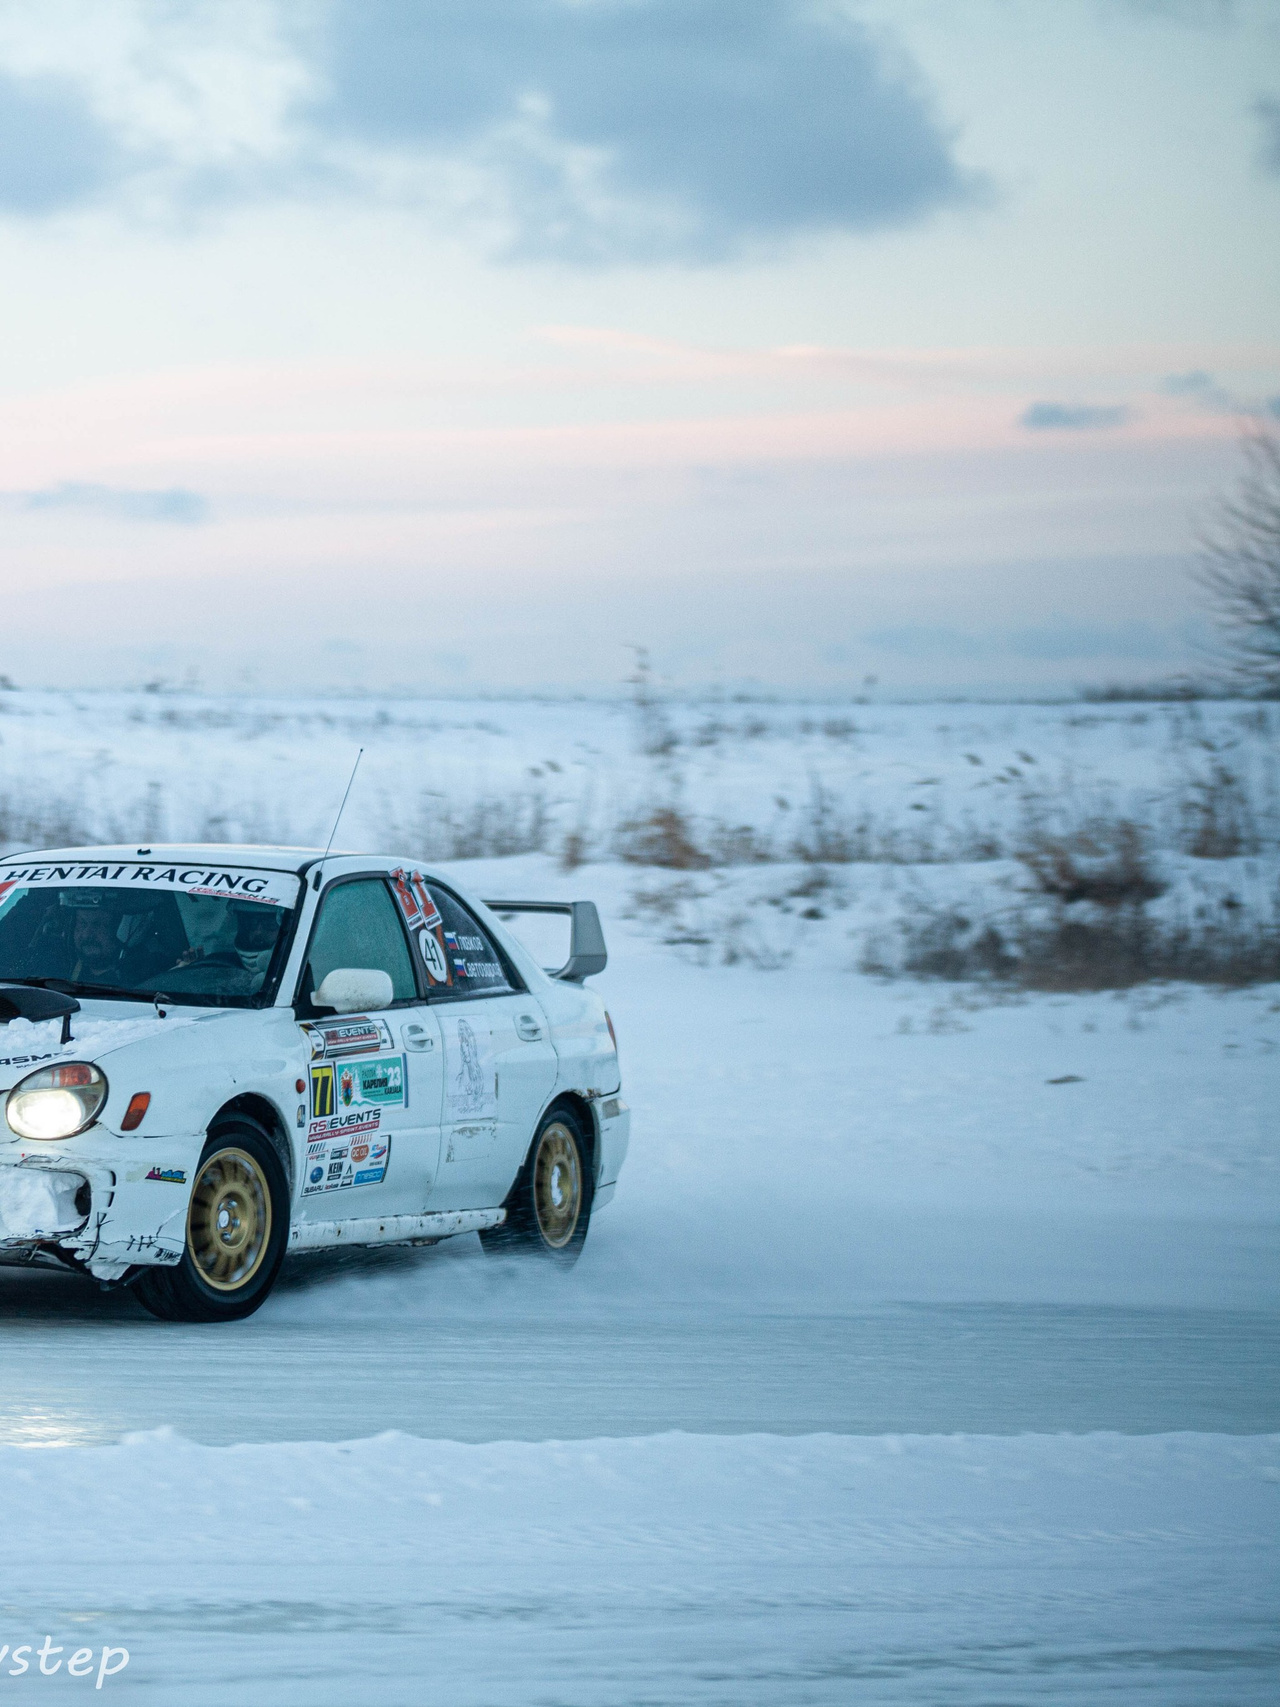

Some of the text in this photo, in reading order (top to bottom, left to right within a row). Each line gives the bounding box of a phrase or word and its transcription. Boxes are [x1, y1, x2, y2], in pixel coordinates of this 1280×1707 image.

[5, 865, 270, 894] HENTAI RACING
[424, 938, 443, 971] 41
[311, 1067, 334, 1117] 77
[304, 1184, 324, 1194] SUBARU
